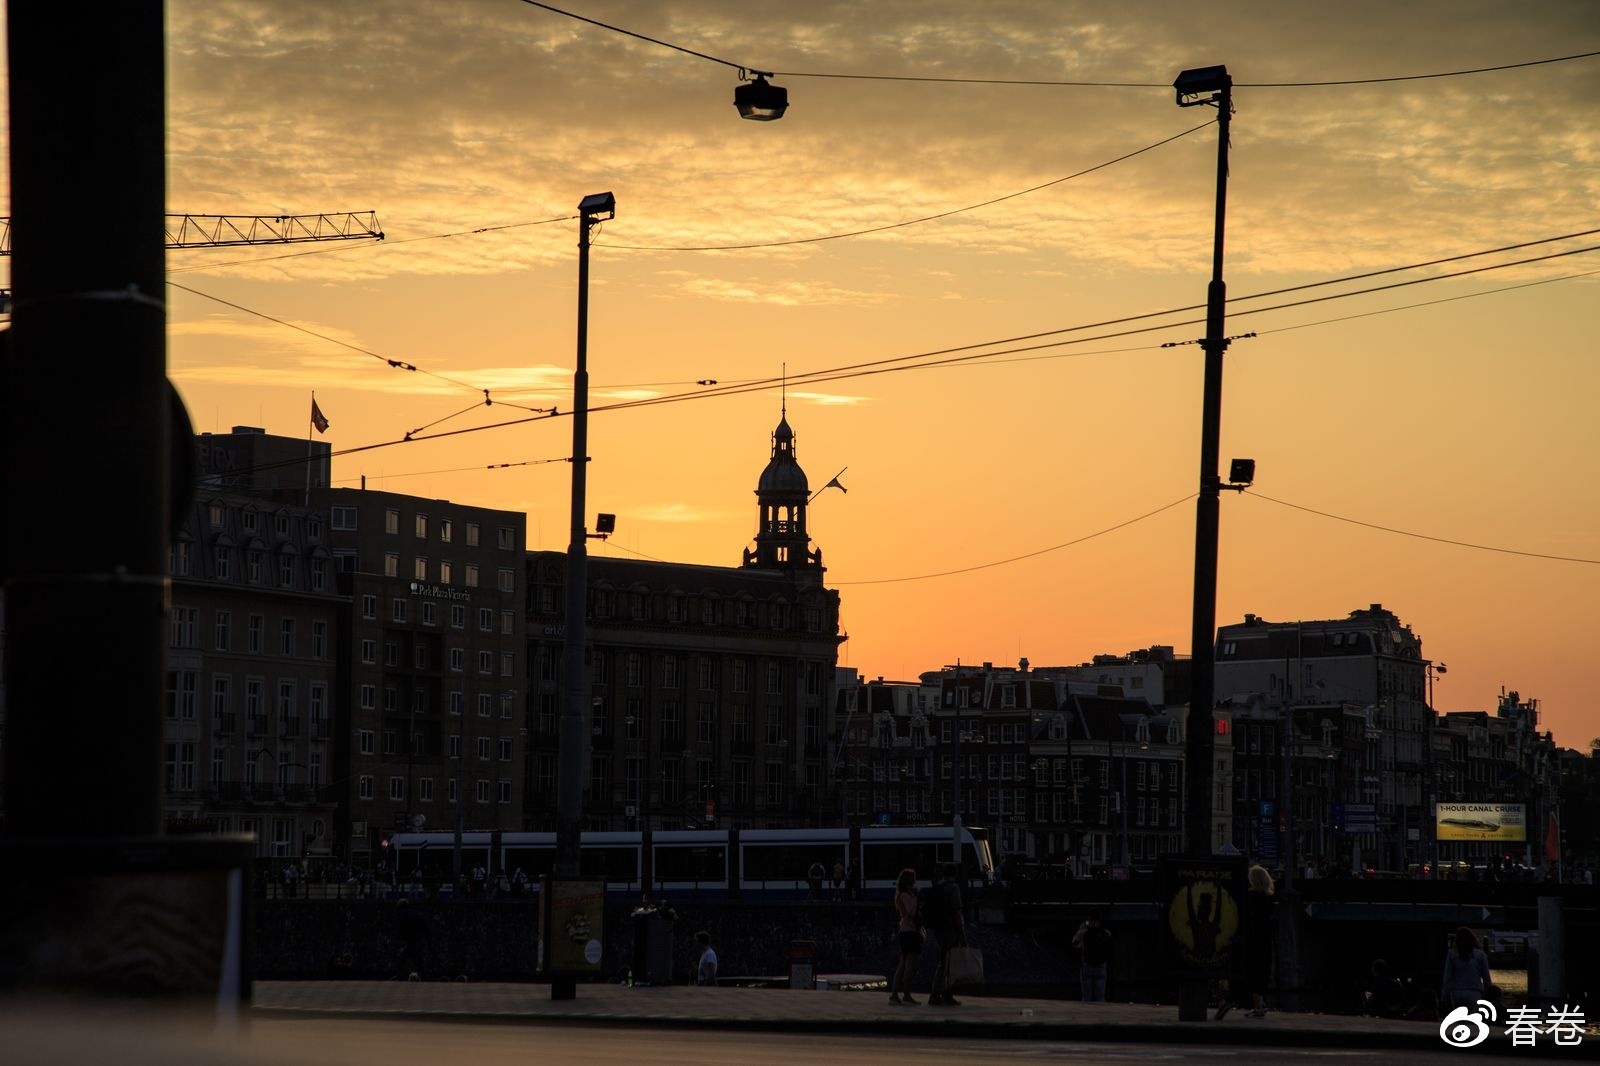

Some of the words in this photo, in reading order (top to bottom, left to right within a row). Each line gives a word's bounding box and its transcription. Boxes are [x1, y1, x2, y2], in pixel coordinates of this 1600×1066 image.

[418, 584, 432, 596] Park
[432, 586, 448, 598] Plaza
[447, 588, 471, 601] Victoria
